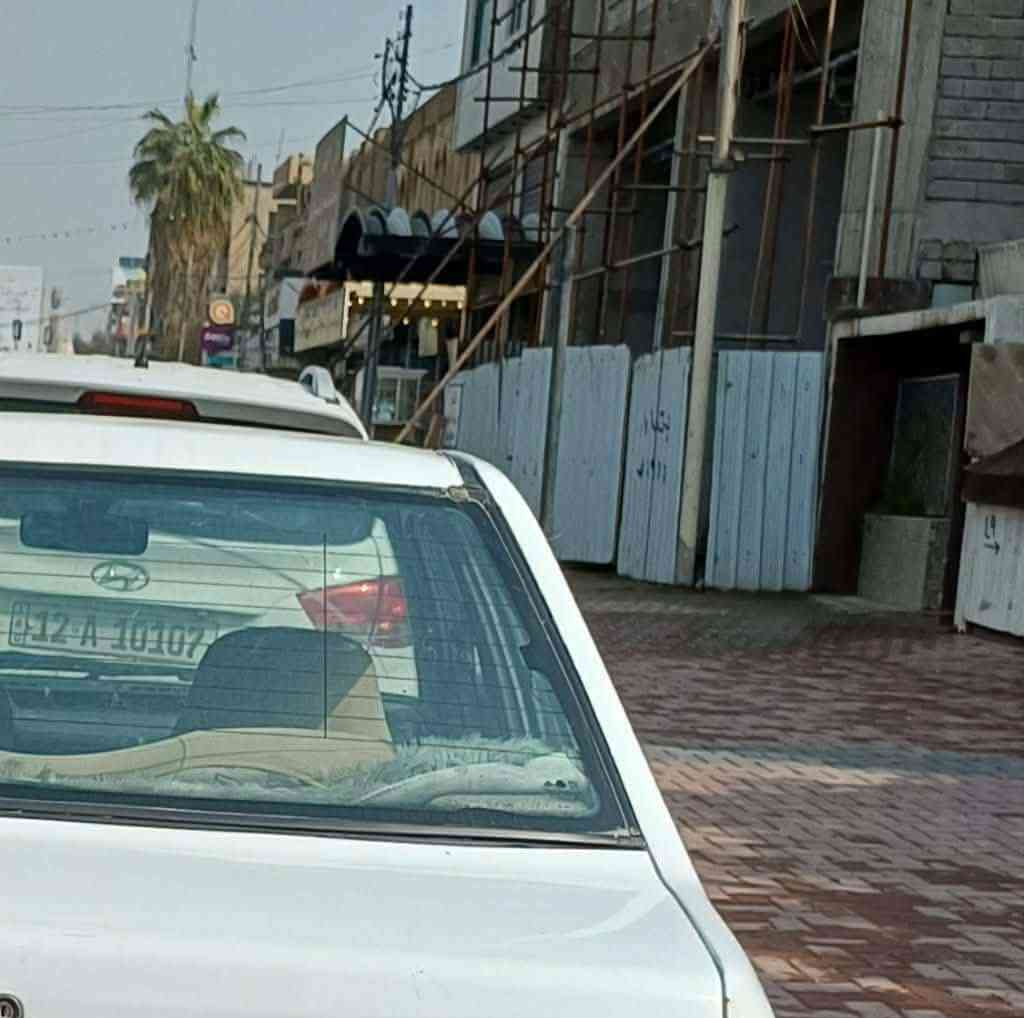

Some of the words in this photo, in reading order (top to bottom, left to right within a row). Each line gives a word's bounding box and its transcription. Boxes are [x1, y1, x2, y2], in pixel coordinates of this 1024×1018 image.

[31, 611, 69, 644] 12
[79, 616, 97, 648] A
[111, 617, 205, 659] 10107
